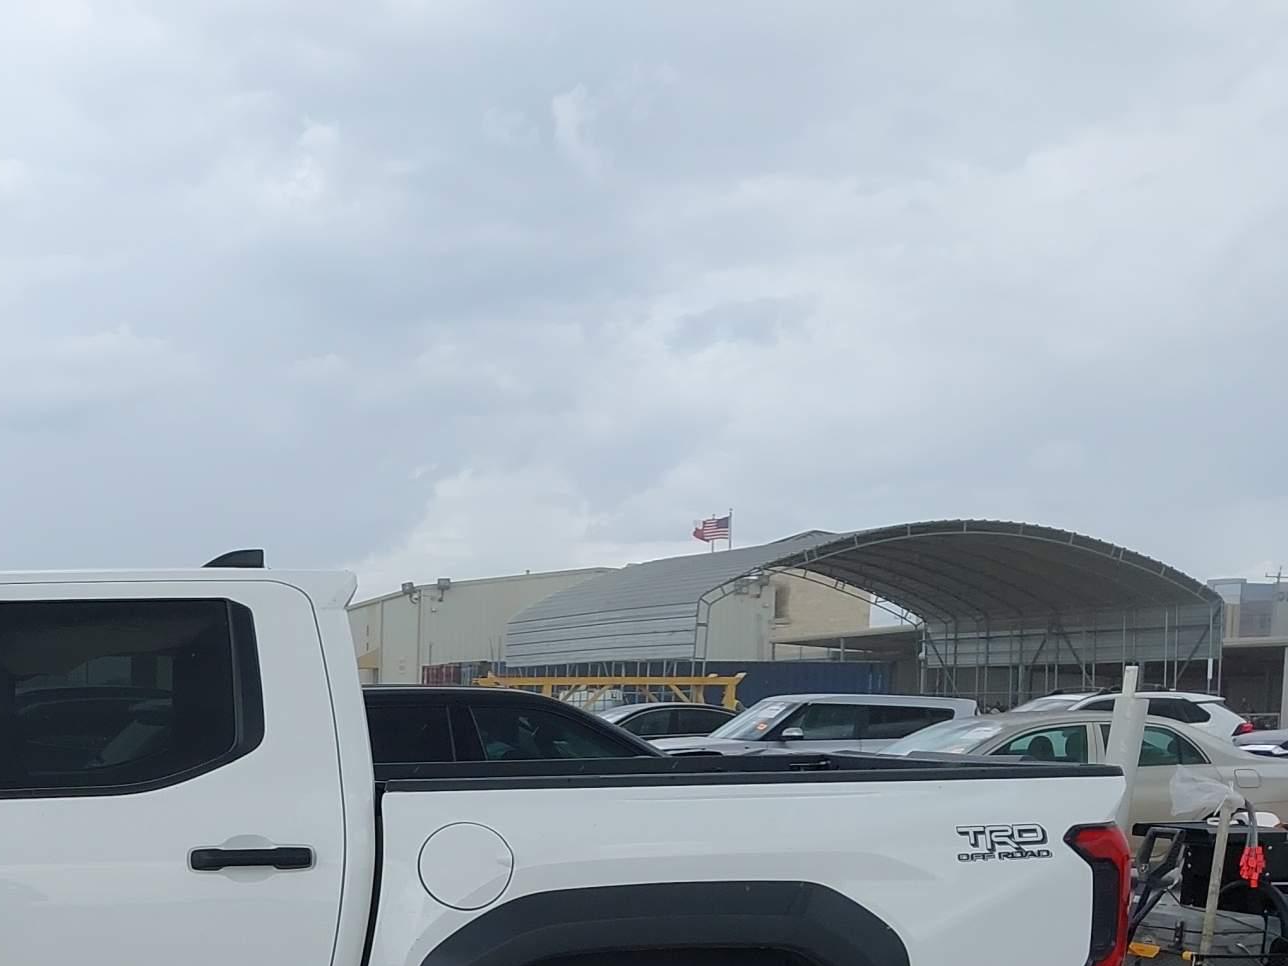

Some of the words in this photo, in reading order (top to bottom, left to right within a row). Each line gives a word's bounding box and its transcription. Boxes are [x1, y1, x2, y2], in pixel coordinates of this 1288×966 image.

[956, 824, 1049, 852] TRD
[957, 852, 995, 862] OFF
[998, 849, 1052, 860] ROAD
